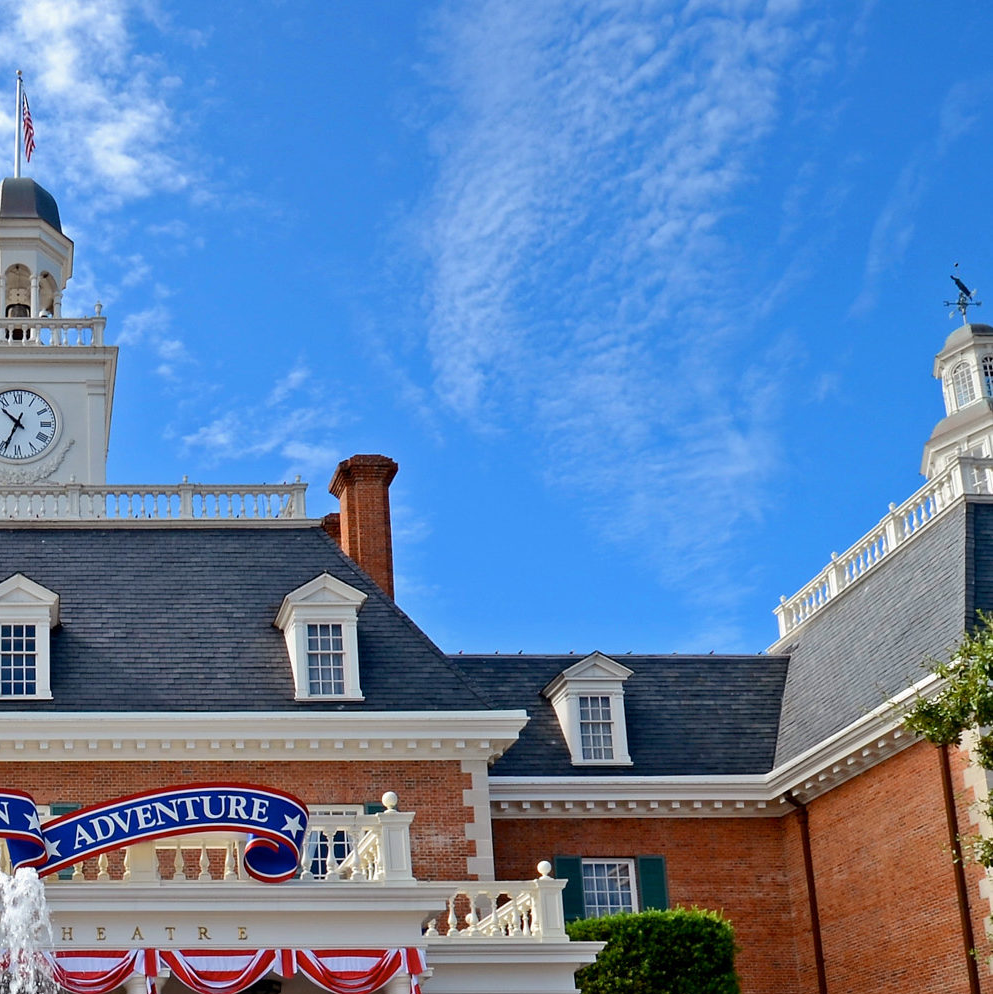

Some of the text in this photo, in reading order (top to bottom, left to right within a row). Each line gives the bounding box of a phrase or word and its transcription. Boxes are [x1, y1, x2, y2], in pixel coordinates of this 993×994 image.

[0, 397, 9, 408] XI
[13, 393, 23, 404] XII
[36, 408, 48, 416] II
[73, 795, 269, 850] ADVENTURE
